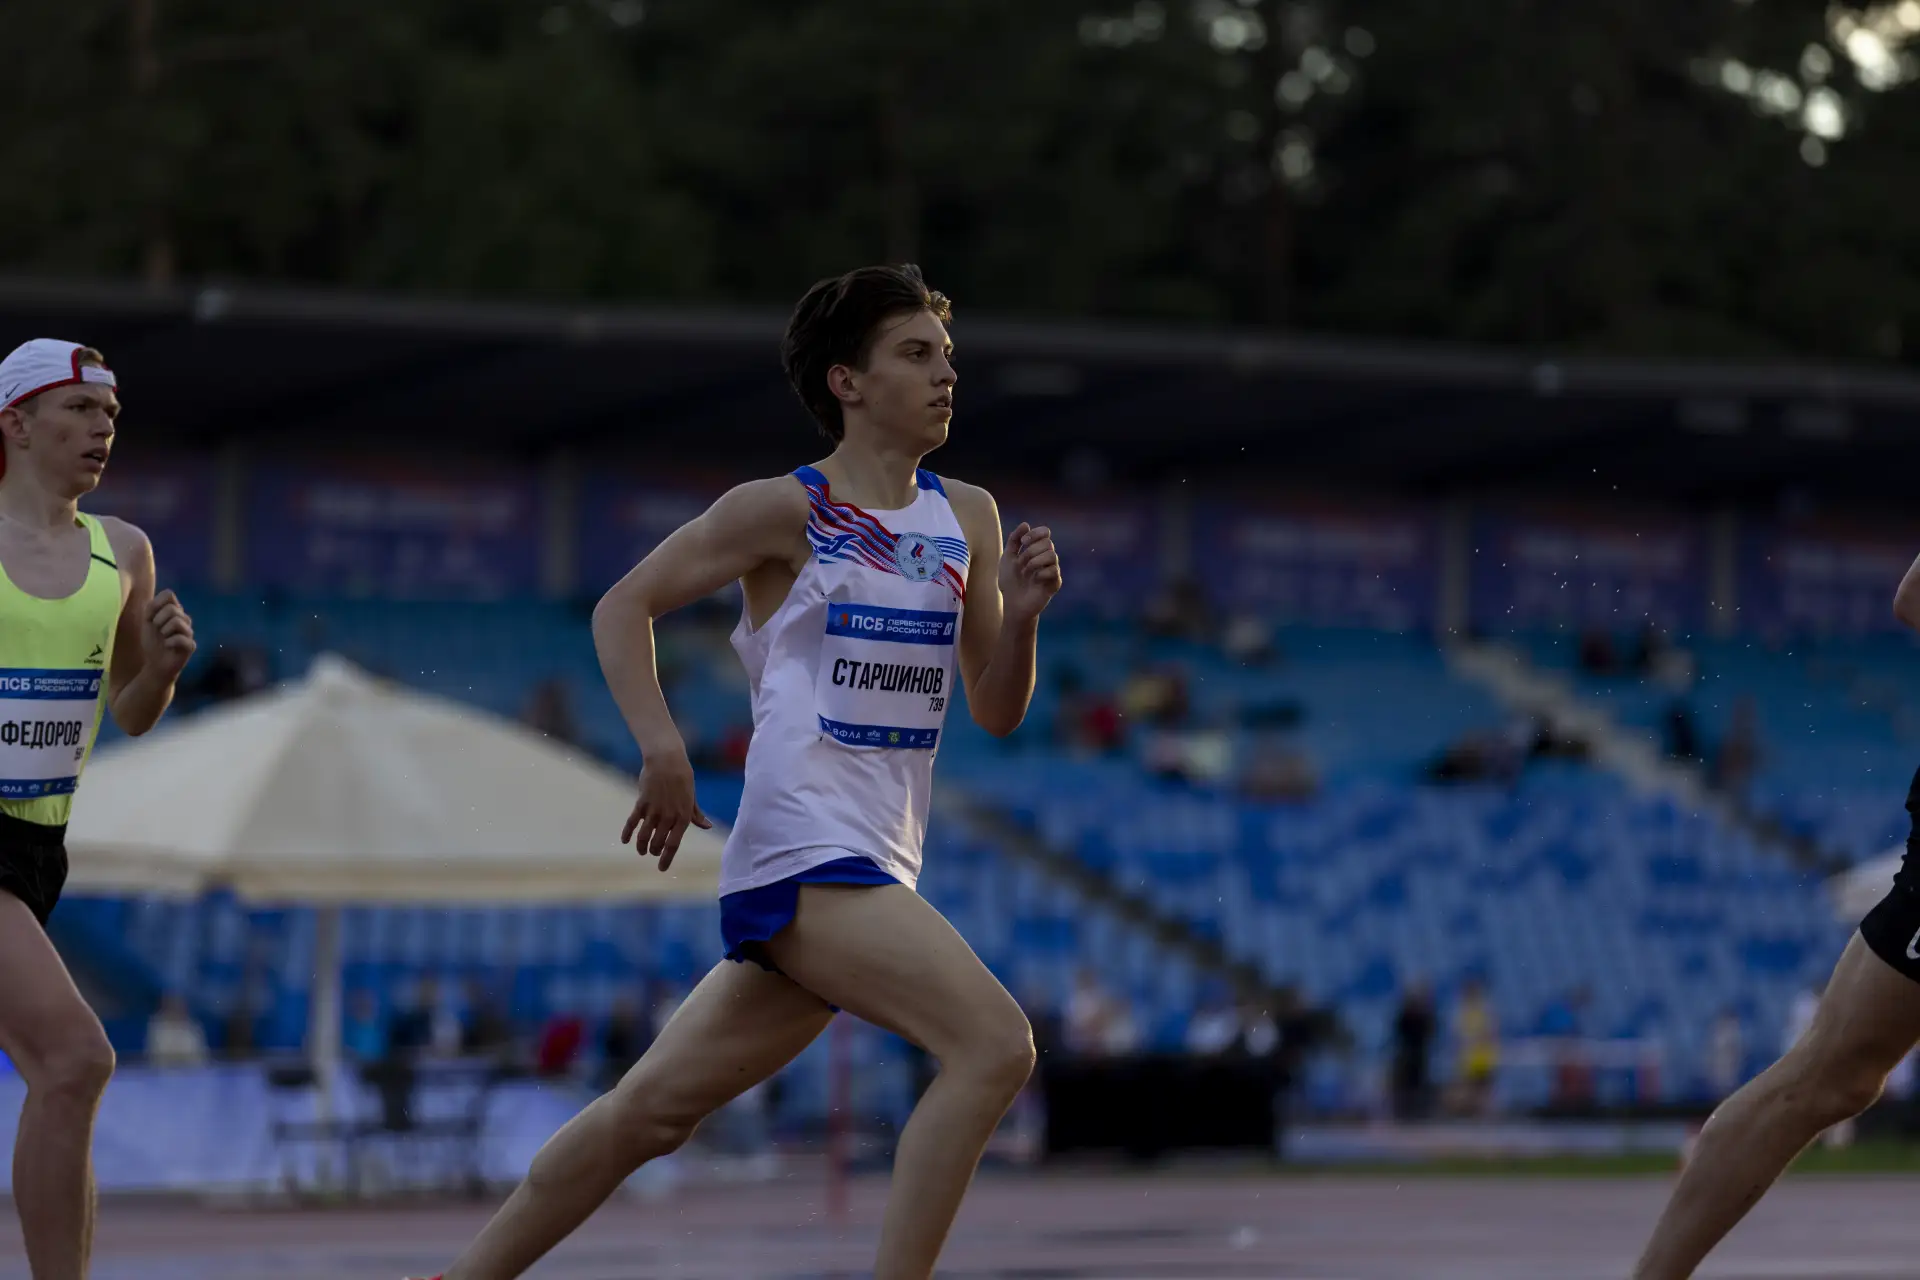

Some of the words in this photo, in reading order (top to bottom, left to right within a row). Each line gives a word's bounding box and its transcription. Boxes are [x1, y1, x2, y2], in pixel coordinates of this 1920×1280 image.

[851, 615, 885, 631] ПСБ
[887, 618, 944, 629] ПЕРВЕНСТВО
[886, 626, 921, 635] РОССИИ
[922, 627, 938, 636] U18
[832, 658, 944, 694] СТАРШИНОВ
[0, 677, 31, 691] ПСБ
[928, 697, 945, 712] 739
[1, 720, 82, 749] ФЕДОРОВ
[832, 729, 861, 740] ВФЛА
[0, 785, 23, 793] ФЛА
